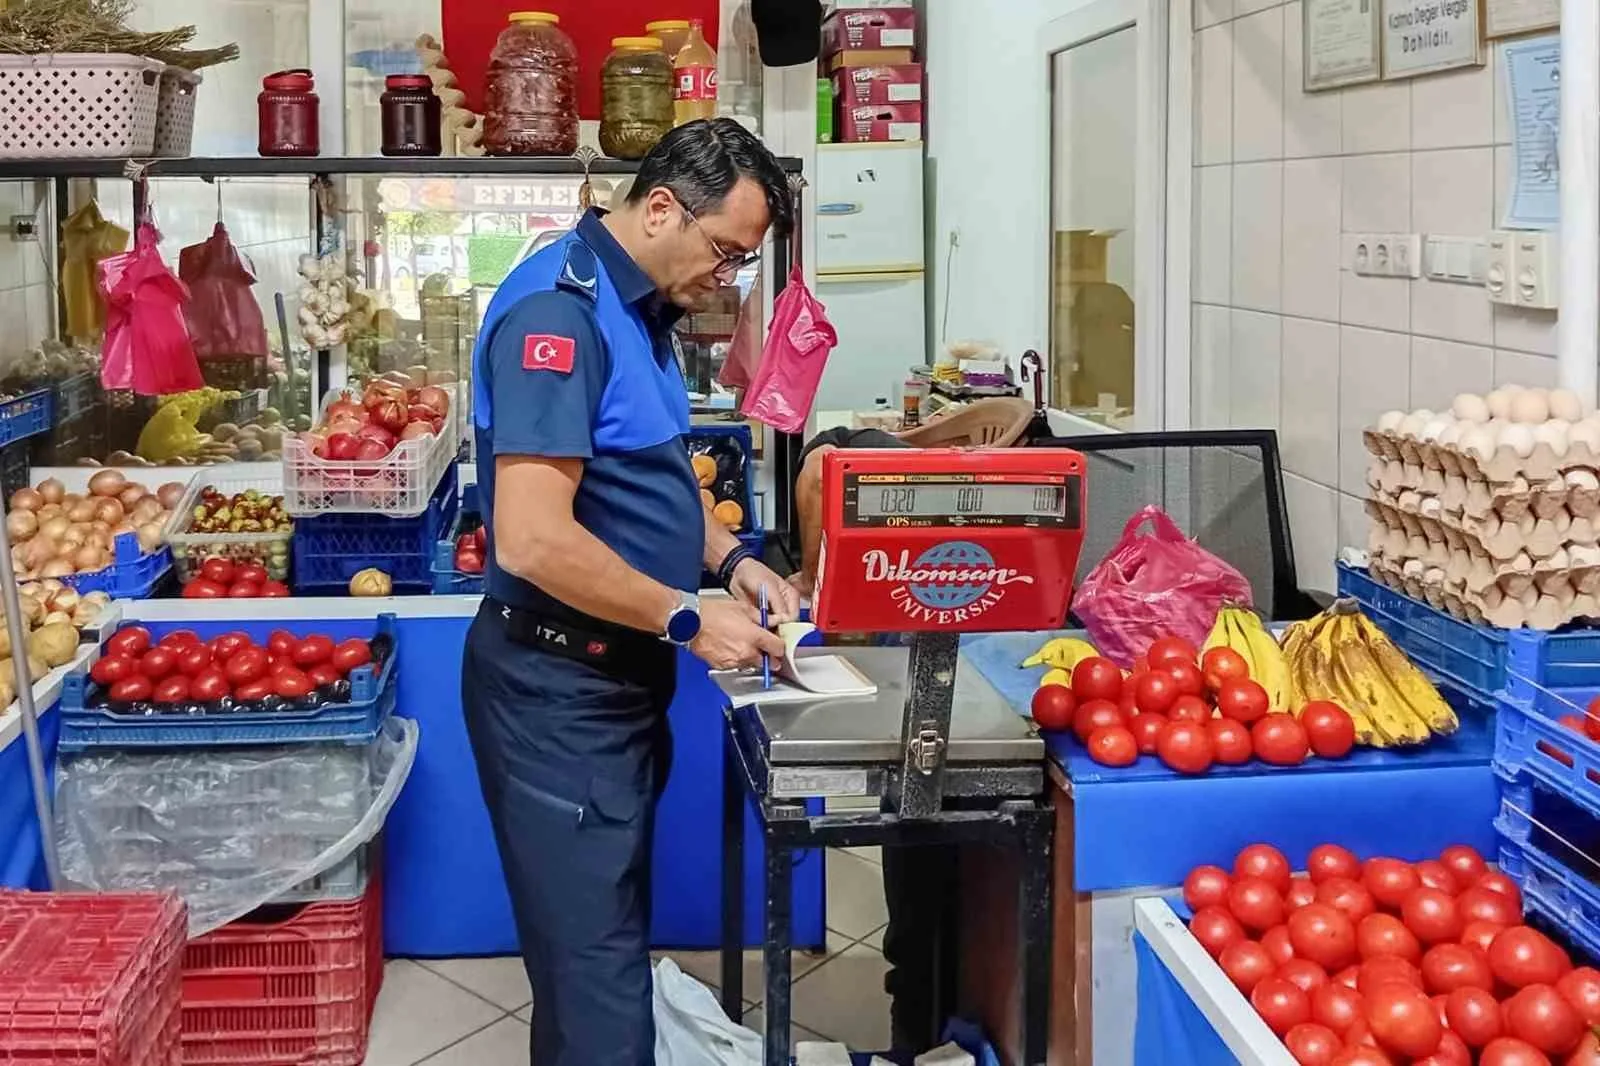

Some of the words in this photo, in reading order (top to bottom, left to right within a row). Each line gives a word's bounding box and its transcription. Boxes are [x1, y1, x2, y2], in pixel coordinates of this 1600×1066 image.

[886, 516, 910, 528] OPS
[861, 548, 1034, 586] Dikomsan
[890, 585, 1006, 626] UNIVERSAL
